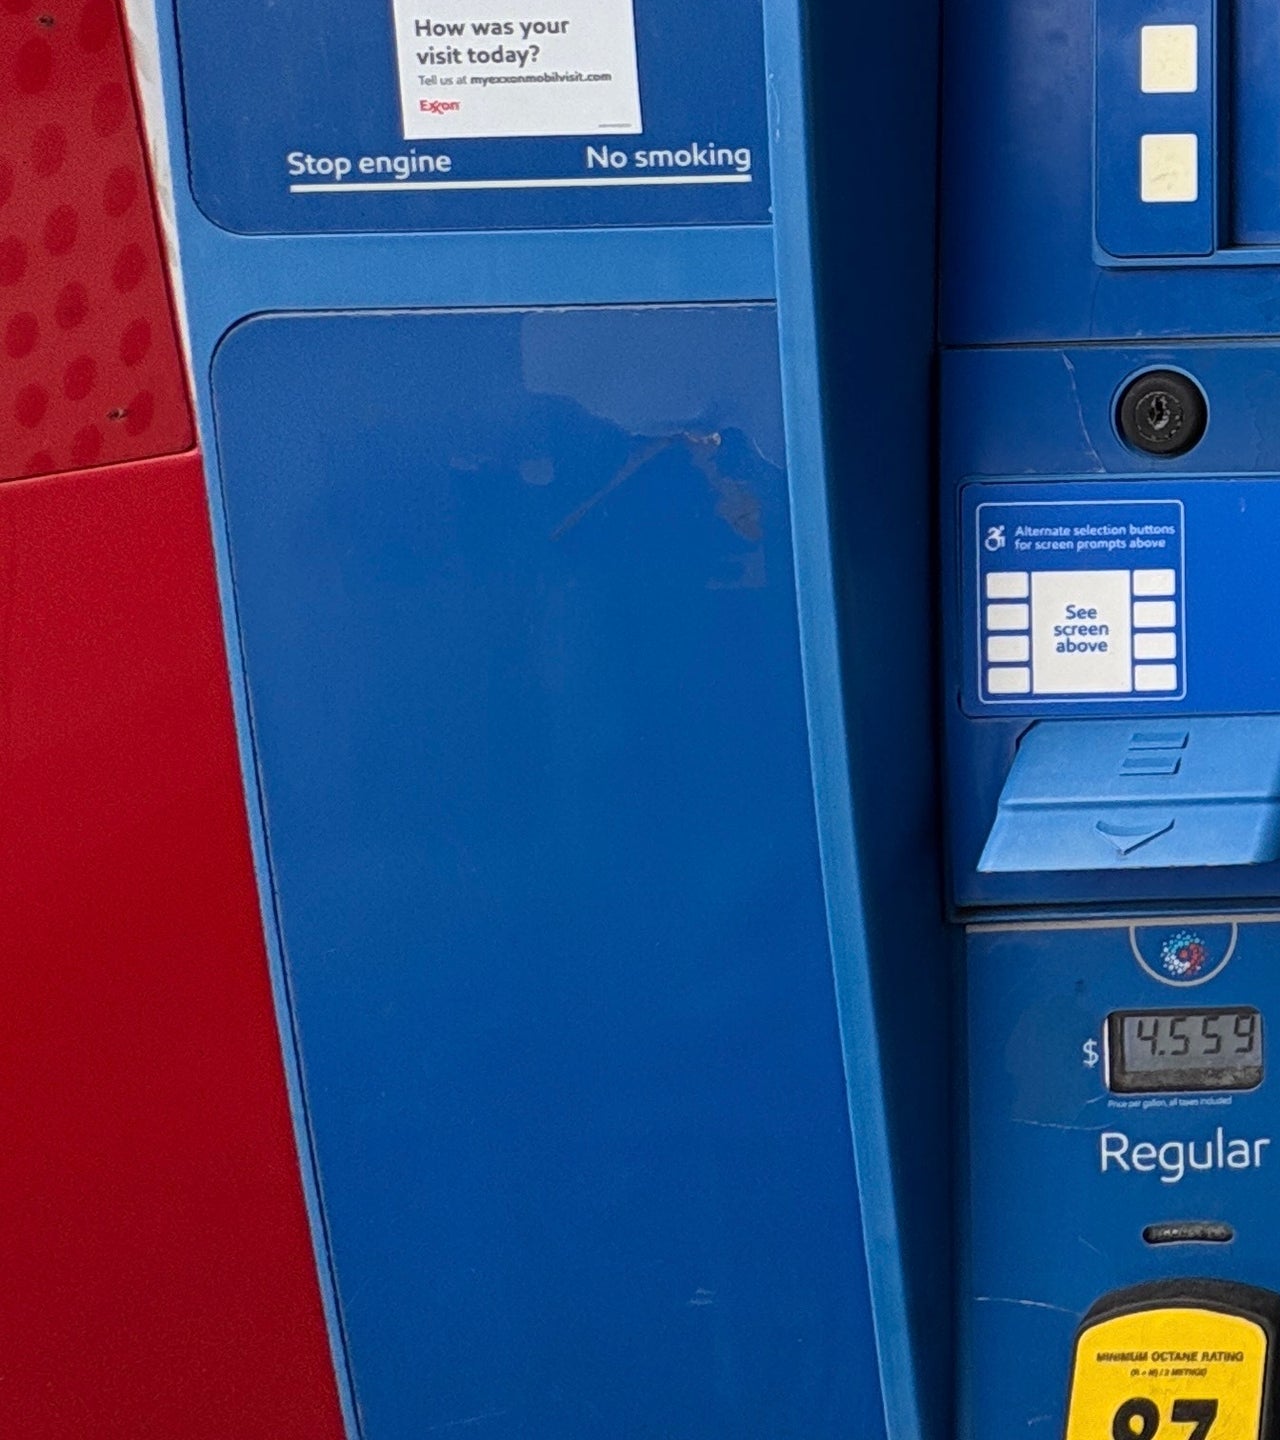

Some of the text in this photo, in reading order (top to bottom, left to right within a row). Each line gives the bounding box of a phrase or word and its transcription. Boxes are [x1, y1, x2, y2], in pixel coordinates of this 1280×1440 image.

[415, 18, 570, 39] How was your
[416, 45, 540, 68] visit today?
[420, 99, 460, 114] Exxon
[288, 143, 752, 183] Stop engine No smoking
[1077, 538, 1125, 553] prompts
[1065, 604, 1097, 620] See
[1054, 622, 1109, 637] screen
[1055, 637, 1108, 653] above
[1137, 1018, 1256, 1057] 4.559
[1083, 1039, 1098, 1067] $
[1101, 1128, 1270, 1183] Regular
